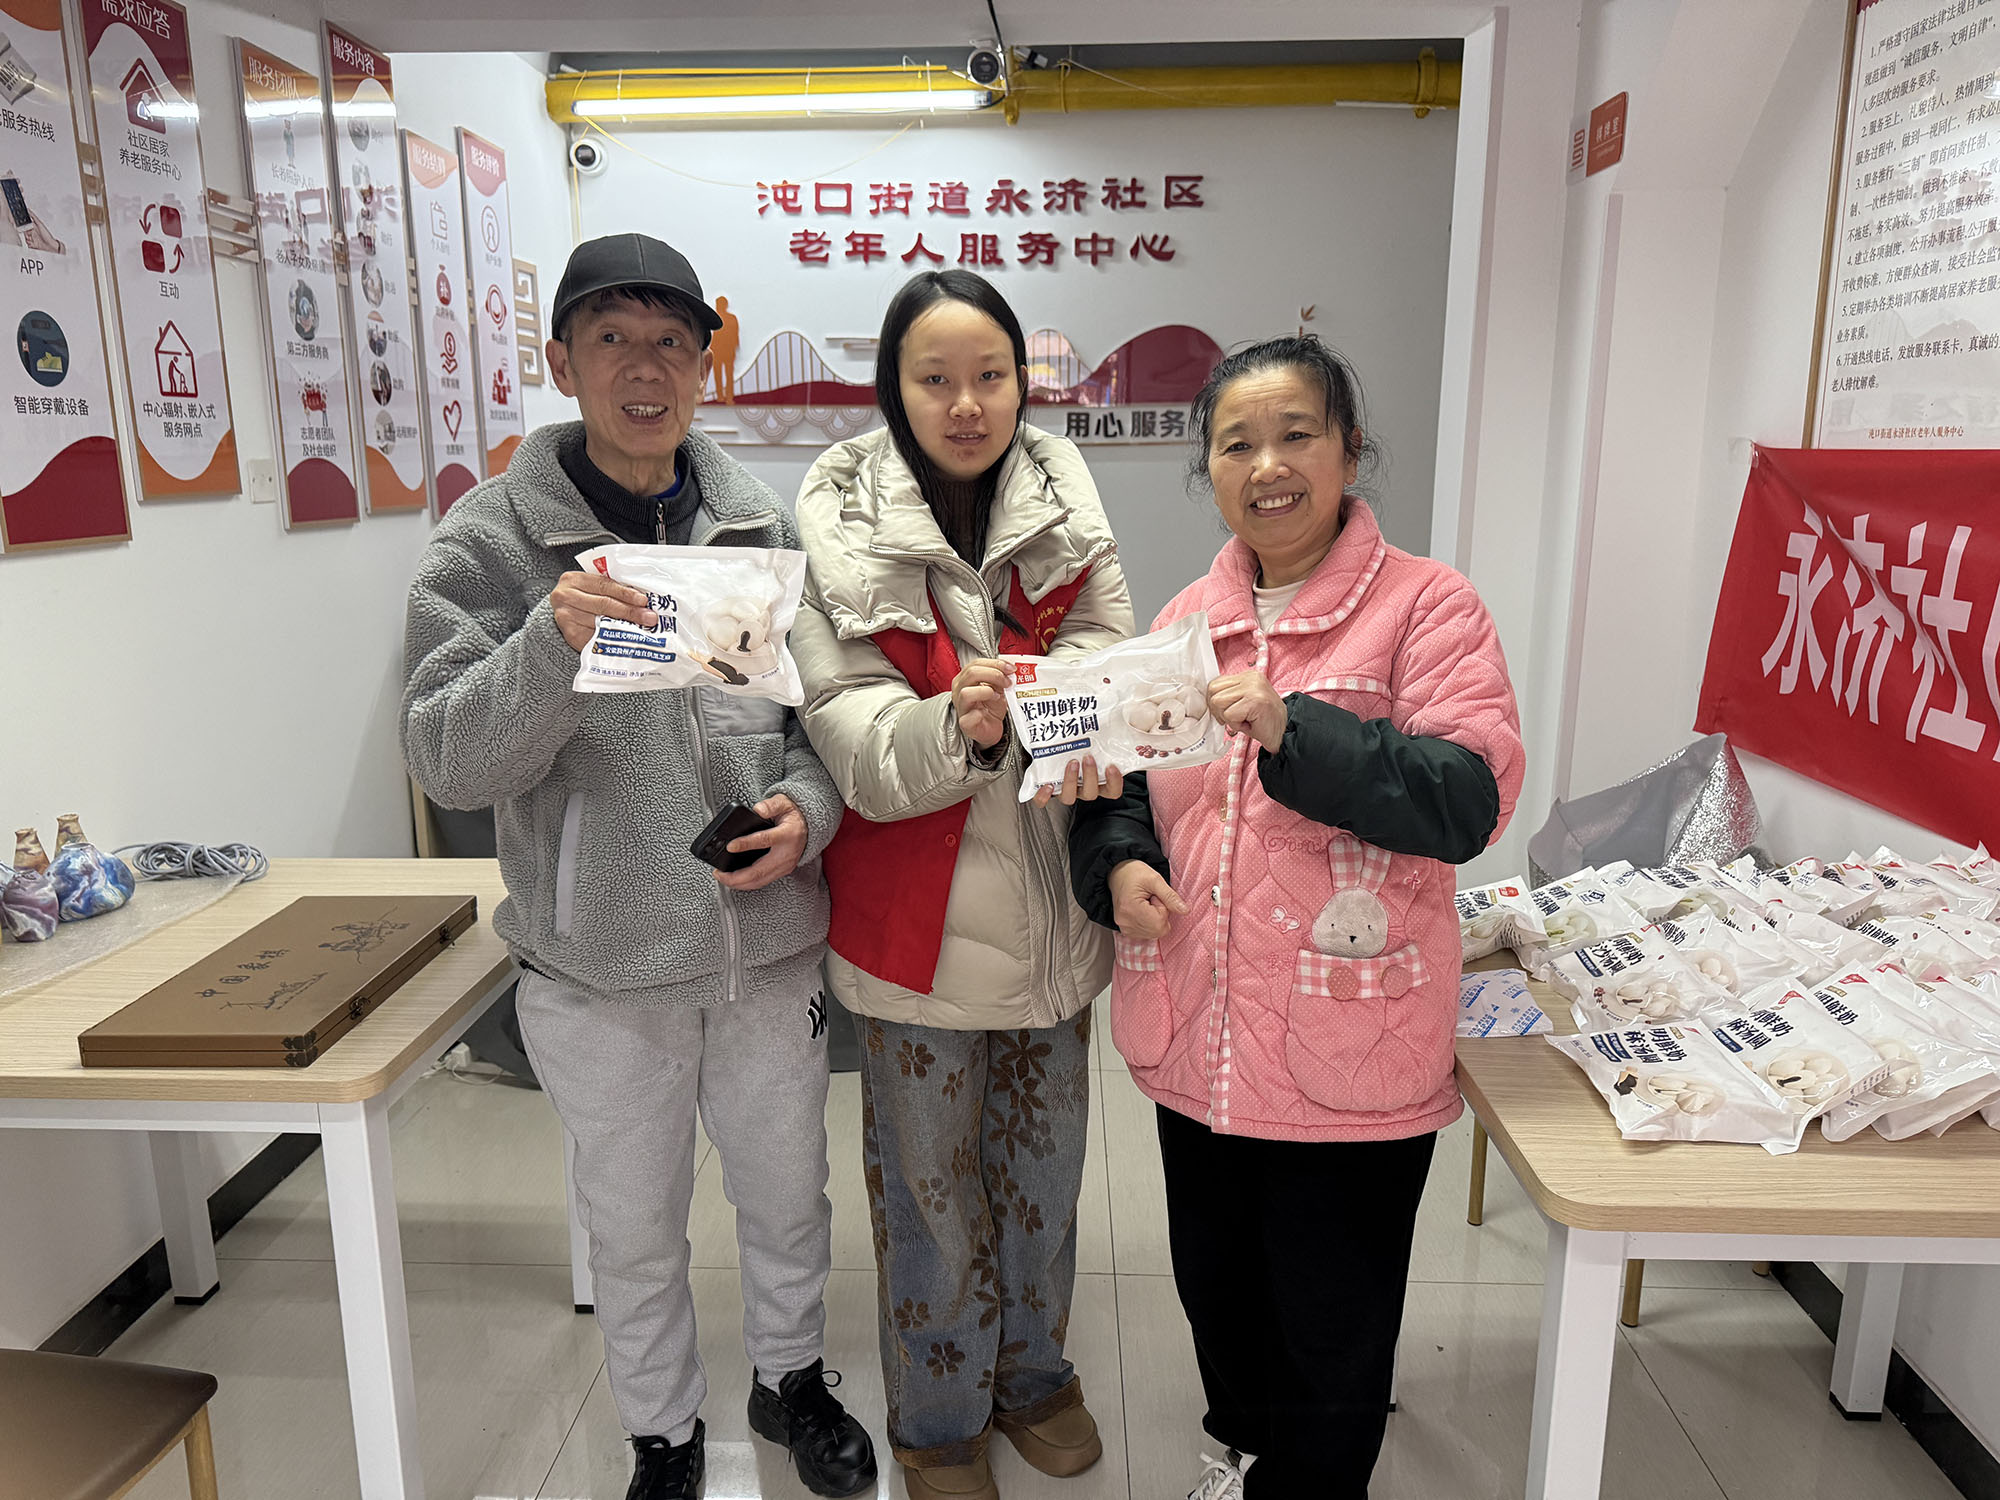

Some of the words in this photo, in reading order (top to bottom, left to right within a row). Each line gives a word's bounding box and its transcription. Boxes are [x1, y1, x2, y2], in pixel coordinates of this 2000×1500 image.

[332, 33, 375, 77] 服务内容
[248, 56, 300, 99] 服务团队
[0, 109, 55, 142] 服务热线
[127, 129, 169, 157] 社区居家
[119, 148, 182, 181] 养老服务中心
[757, 176, 1205, 215] 沌口街道永济社区
[789, 229, 1176, 265] 老年人服务中心
[20, 258, 44, 276] APP
[159, 281, 180, 300] 互动
[13, 395, 90, 417] 智能穿戴设备
[142, 401, 216, 420] 中心辐射、嵌入式
[163, 422, 203, 438] 服务网点
[1761, 500, 2000, 762] 永济社
[1020, 695, 1098, 722] 光明鲜奶
[1028, 713, 1099, 743] 豆沙汤圆
[1590, 941, 1627, 976] 沙汤圆
